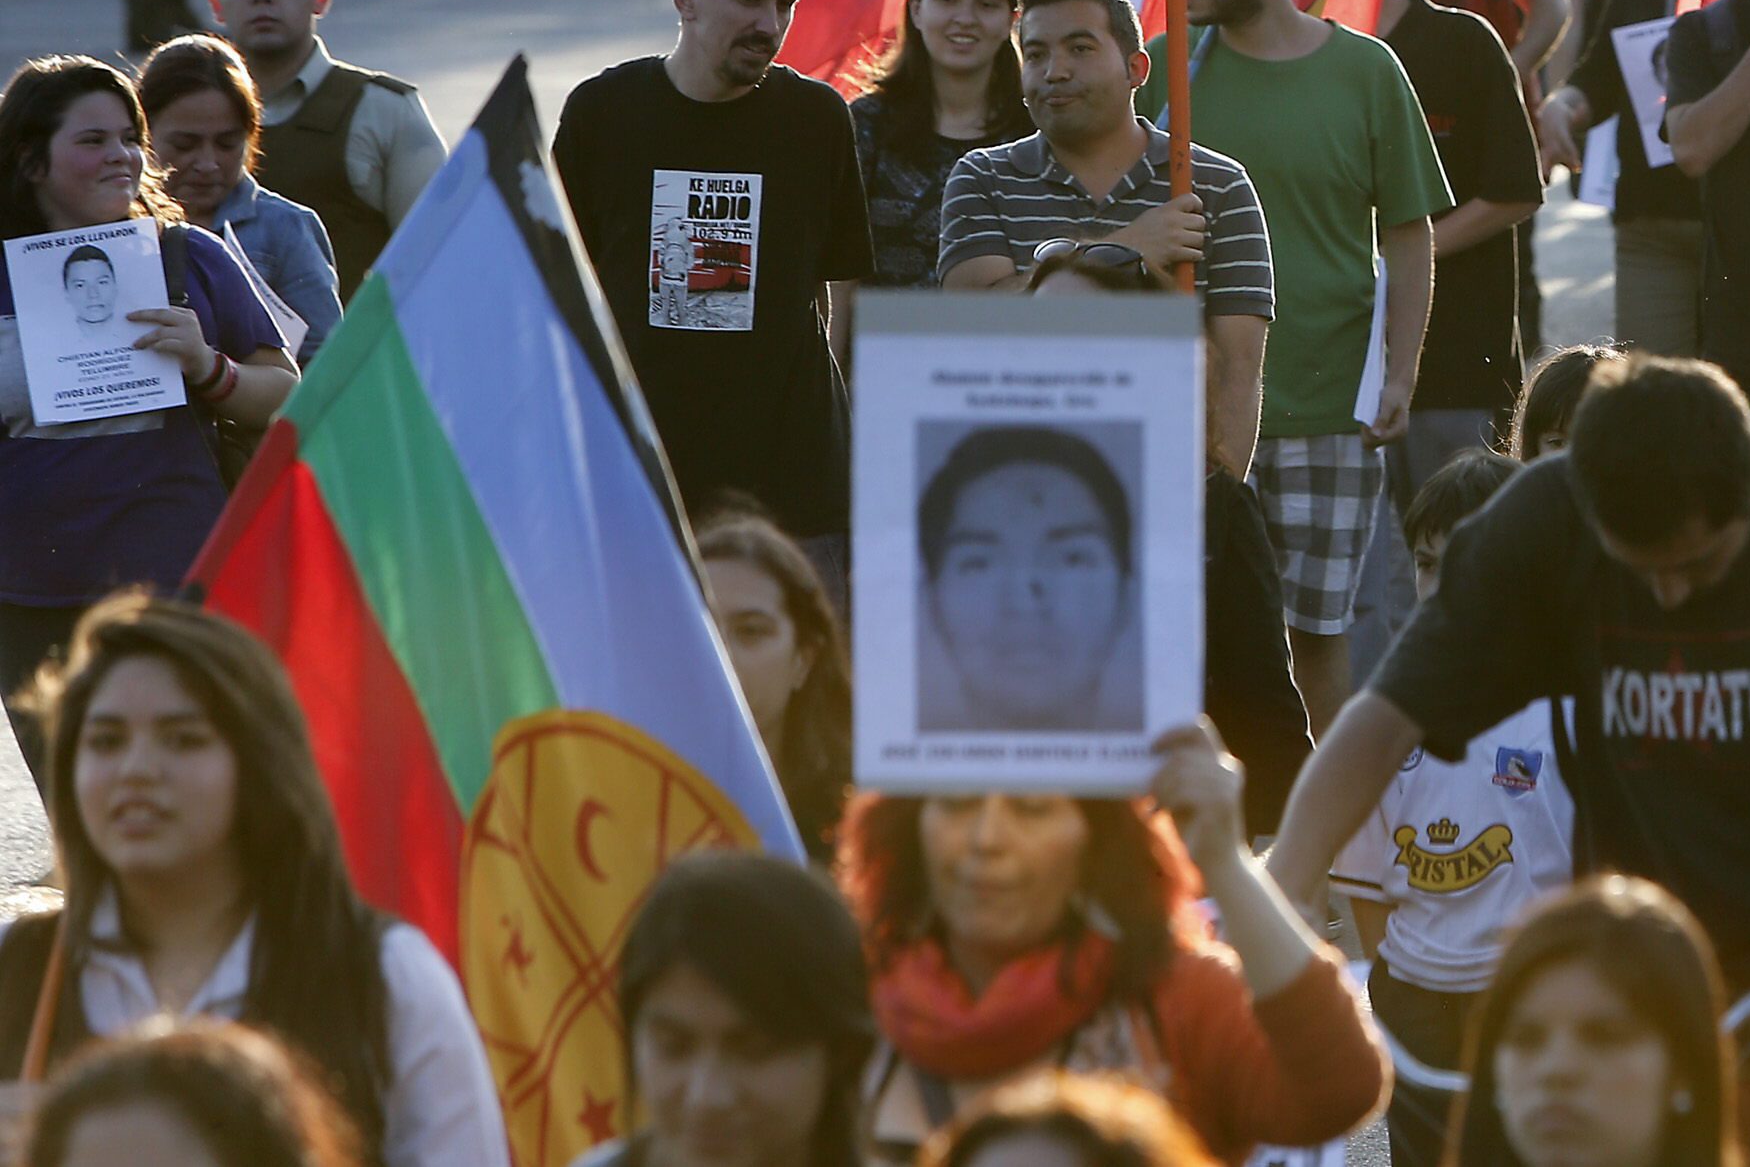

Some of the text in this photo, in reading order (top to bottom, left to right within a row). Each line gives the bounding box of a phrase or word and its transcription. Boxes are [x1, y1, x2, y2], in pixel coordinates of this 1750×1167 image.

[689, 178, 750, 194] KE HUELGA
[688, 194, 751, 220] RADIO
[104, 346, 134, 356] ALFON
[86, 385, 104, 396] LOS
[1408, 842, 1502, 882] RISTAL
